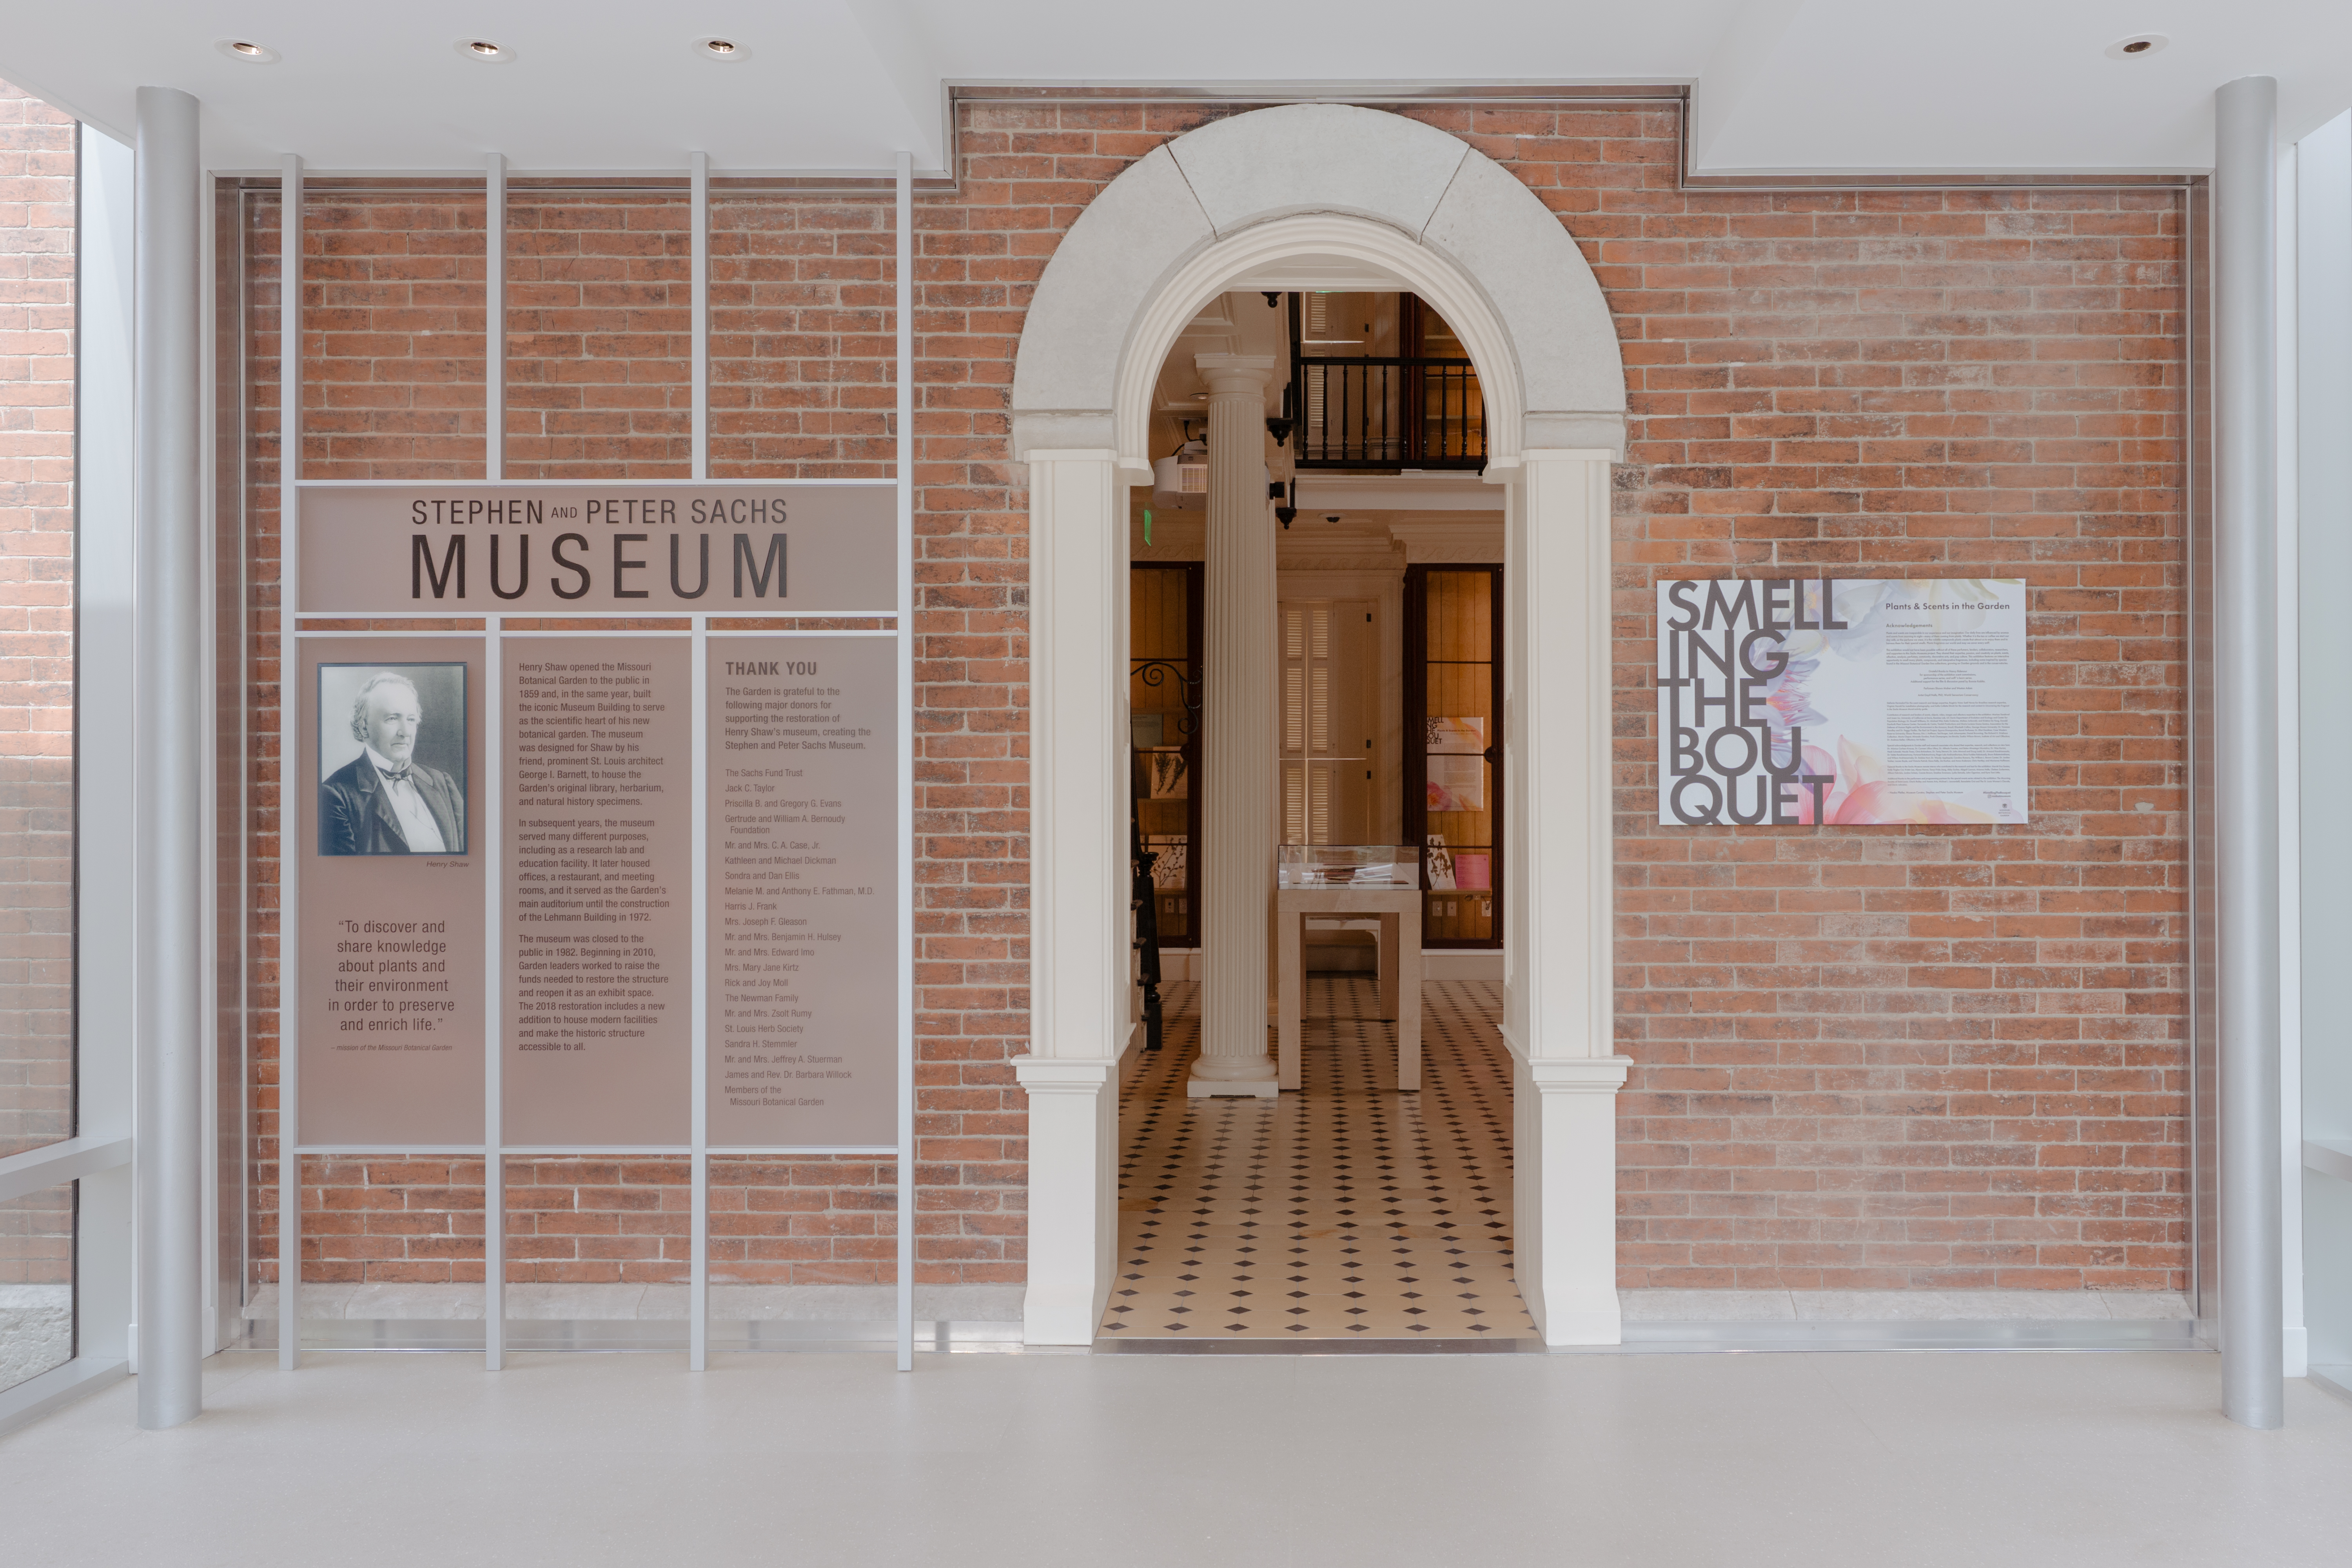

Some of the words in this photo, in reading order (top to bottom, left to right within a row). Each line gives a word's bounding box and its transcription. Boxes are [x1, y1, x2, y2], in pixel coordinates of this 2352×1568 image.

[412, 500, 543, 525] STEPHEN
[551, 507, 577, 518] AND
[587, 499, 676, 524] PETER
[691, 499, 787, 524] SACHS
[412, 533, 787, 600] MUSEUM
[1666, 580, 1848, 631] SMELL
[1670, 628, 1789, 679] ING
[519, 662, 543, 673] Henry
[544, 662, 568, 671] Shaw
[570, 662, 599, 673] opened
[601, 662, 615, 671] the
[617, 662, 652, 671] Missouri
[725, 661, 779, 675] THANK
[786, 661, 817, 675] YOU
[519, 676, 556, 685] Botanical
[559, 676, 587, 685] Garden
[590, 676, 598, 684] to
[600, 676, 613, 684] the
[615, 676, 640, 686] public
[642, 676, 650, 684] in
[519, 690, 539, 698] 1859
[541, 690, 559, 699] and,
[561, 690, 569, 698] in
[571, 690, 584, 698] the
[610, 691, 631, 700] year,
[633, 689, 652, 698] built
[725, 687, 740, 696] The
[742, 687, 771, 696] Garden
[774, 687, 781, 696] is
[783, 687, 814, 697] grateful
[817, 687, 825, 696] to
[827, 687, 840, 696] the
[1658, 678, 1767, 728] THE
[725, 740, 759, 751] Stephen
[760, 741, 776, 750] and
[778, 741, 800, 750] Peter
[802, 740, 826, 750] Sachs
[829, 741, 866, 750] Museum.
[1670, 726, 1801, 777] BOU
[519, 757, 545, 766] friend,
[547, 757, 589, 767] prominent
[590, 757, 601, 765] St.
[604, 757, 626, 765] Louis
[628, 757, 664, 765] architect
[725, 769, 739, 777] The
[740, 768, 763, 777] Sachs
[765, 769, 783, 777] Fund
[784, 768, 803, 777] Trust
[725, 784, 742, 792] Jack
[744, 784, 752, 792] C.
[753, 784, 775, 794] Taylor
[1670, 774, 1834, 825] QUET
[725, 887, 753, 895] Melanie
[755, 887, 764, 895] M.
[781, 887, 811, 897] Anthony
[813, 887, 820, 895] E.
[822, 887, 856, 896] Fathman,
[858, 887, 875, 895] M.D.
[519, 913, 527, 922] of
[528, 913, 542, 922] the
[544, 913, 581, 922] Lehmann
[584, 913, 617, 923] Building
[619, 913, 626, 921] in
[629, 913, 652, 921] 1972.
[364, 920, 417, 933] discover
[422, 920, 445, 933] and
[337, 940, 372, 953] share
[377, 940, 446, 955] knowledge
[519, 948, 543, 958] public
[546, 948, 553, 956] in
[556, 948, 578, 956] 1982.
[581, 947, 621, 958] Beginning
[623, 948, 631, 956] in
[633, 948, 655, 957] 2010,
[338, 959, 374, 972] about
[379, 959, 417, 975] plants
[422, 959, 445, 972] and
[335, 979, 364, 992] their
[368, 979, 448, 992] environment
[724, 978, 740, 987] Rick
[742, 978, 756, 987] and
[758, 978, 771, 988] Joy
[773, 978, 788, 987] Moll
[328, 998, 339, 1011] in
[344, 998, 378, 1011] order
[382, 999, 394, 1011] to
[399, 1001, 454, 1014] preserve
[518, 1002, 534, 1010] The
[536, 1002, 556, 1011] 2018
[558, 1002, 602, 1010] restoration
[604, 1002, 638, 1010] includes
[340, 1018, 363, 1031] and
[368, 1018, 408, 1031] enrich
[518, 1042, 561, 1051] accessible
[563, 1042, 572, 1051] to
[573, 1042, 586, 1051] all.
[724, 1085, 759, 1094] Members
[760, 1085, 768, 1094] of
[769, 1085, 782, 1094] the
[730, 1098, 760, 1106] Missouri
[762, 1098, 796, 1106] Botanical
[798, 1098, 824, 1106] Garden
